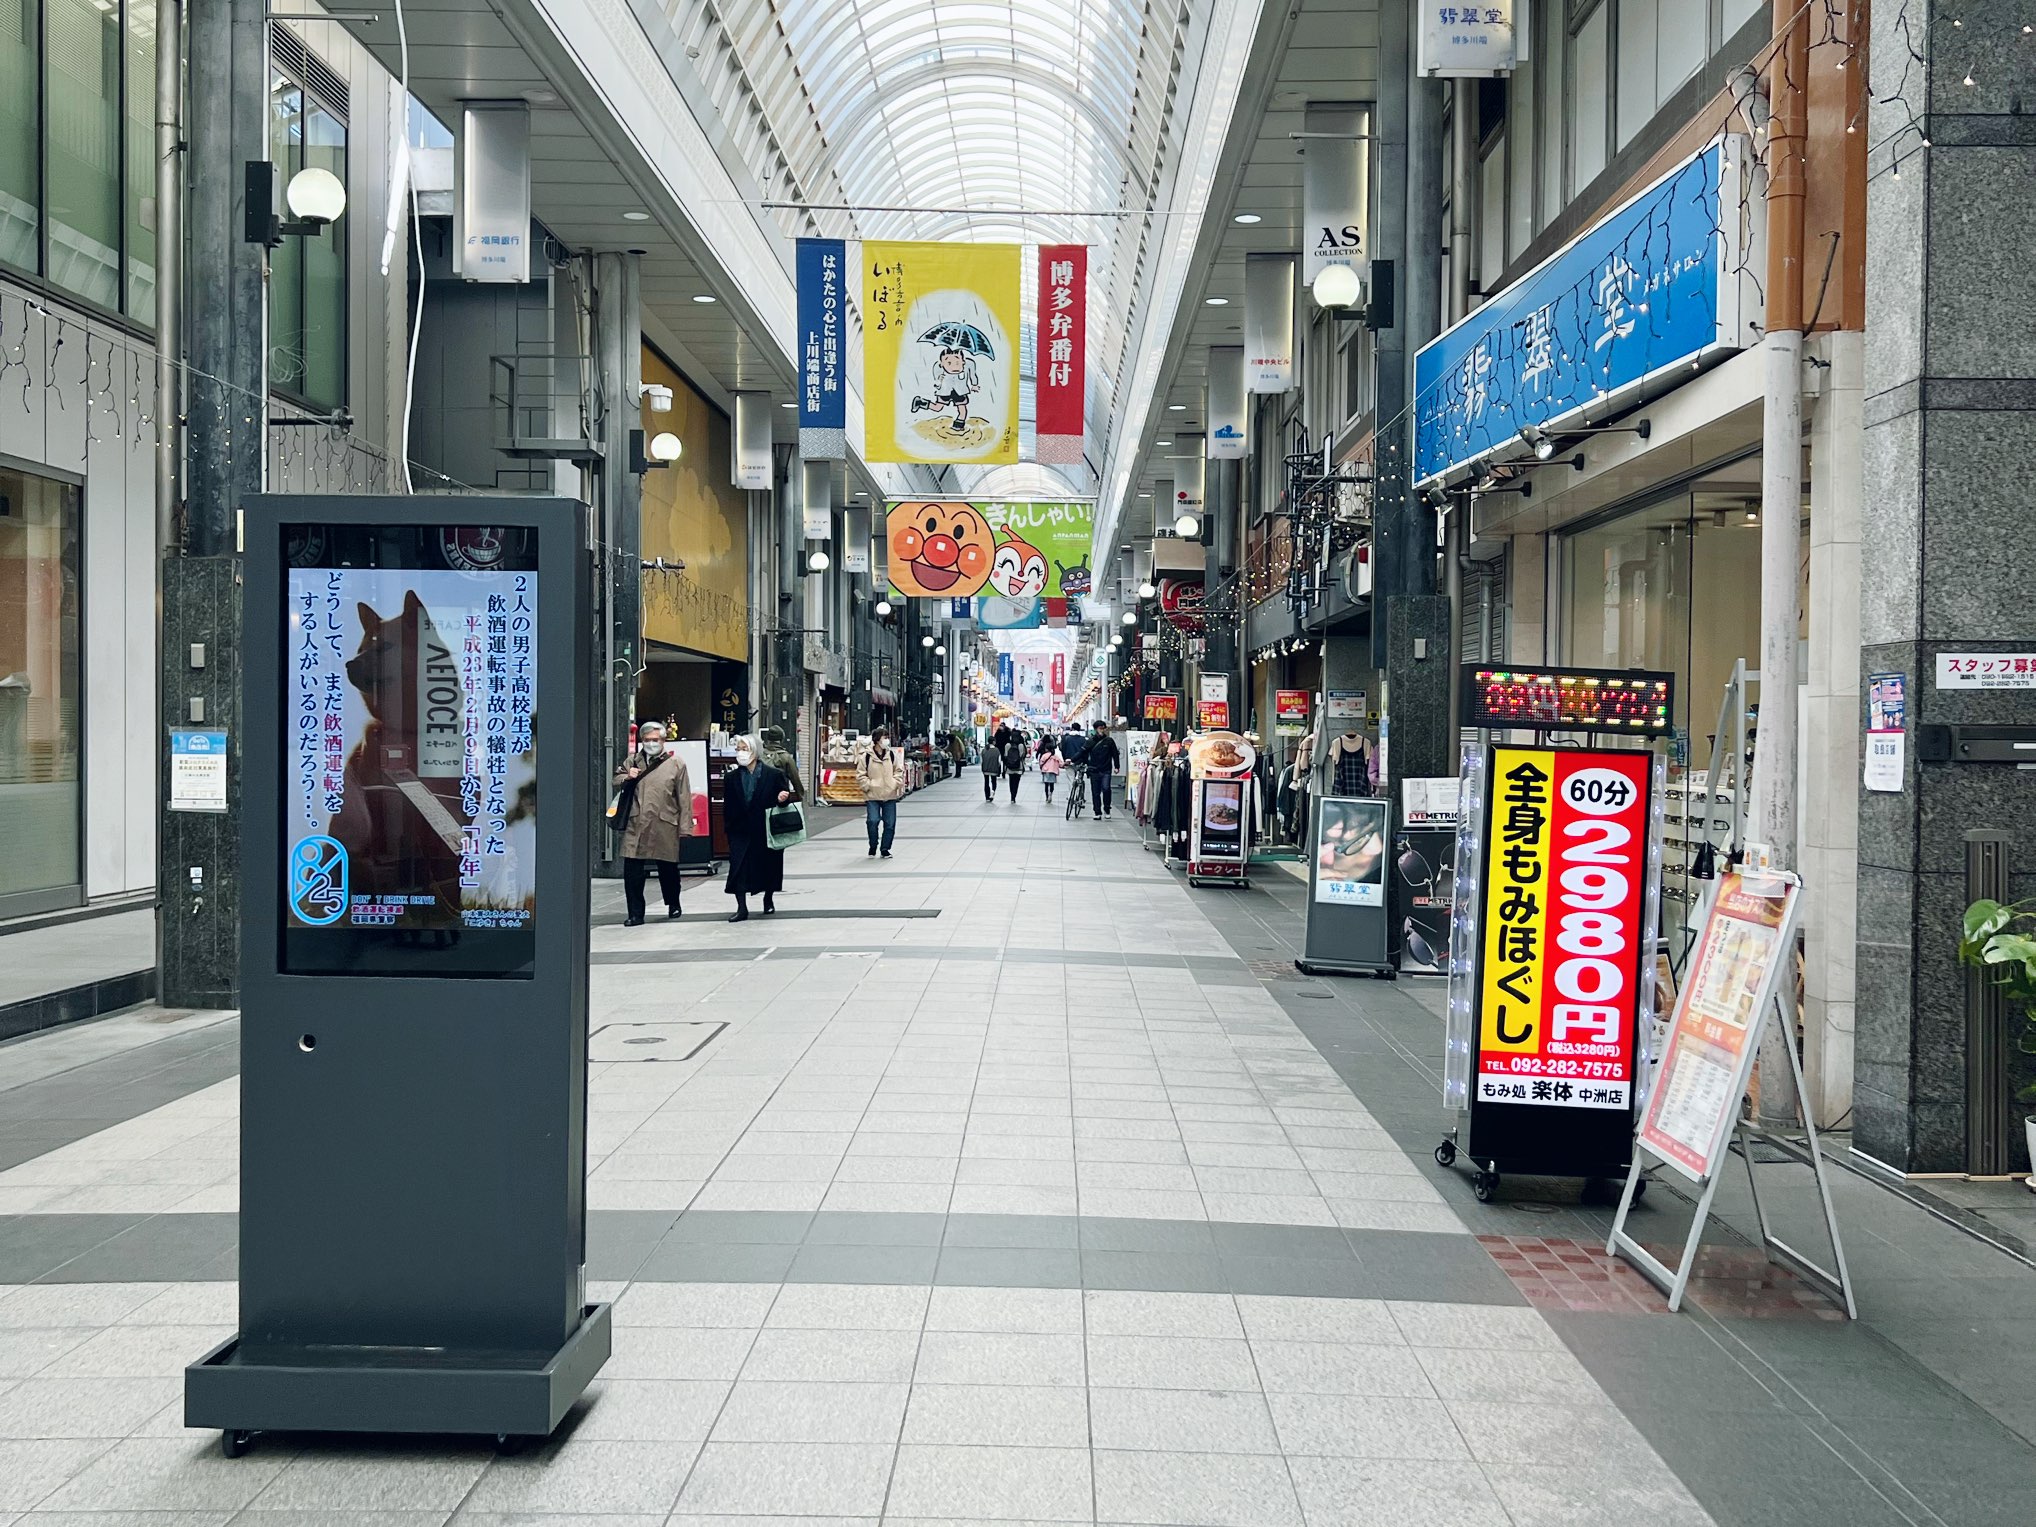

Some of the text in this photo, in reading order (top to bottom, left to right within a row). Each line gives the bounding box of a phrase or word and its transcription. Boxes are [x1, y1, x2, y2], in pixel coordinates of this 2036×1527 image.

[1439, 8, 1503, 26] 翡翠堂
[481, 235, 520, 245] 福岡銀行
[1317, 226, 1361, 248] AS
[1314, 248, 1363, 257] COLLECTION
[822, 254, 837, 392] はかたの心に出逢う街
[1048, 260, 1074, 388] 博多弁番付
[1461, 256, 1636, 426] 翡翠堂
[806, 331, 820, 413] 上川端商店街
[511, 575, 531, 754] 2人の男子高校生が
[486, 594, 506, 854] 飲酒運転事故の犠牲となった
[1570, 778, 1630, 807] 60分
[1329, 882, 1371, 895] 翡翠堂
[1496, 761, 1549, 1045] 全身もみほぐし
[1551, 819, 1632, 1044] 2980円
[1547, 1042, 1620, 1058] (税込3280円)
[1486, 1058, 1623, 1078] TEL. 092-282-7575
[1483, 1080, 1623, 1105] もみ処 楽体 中洲店
